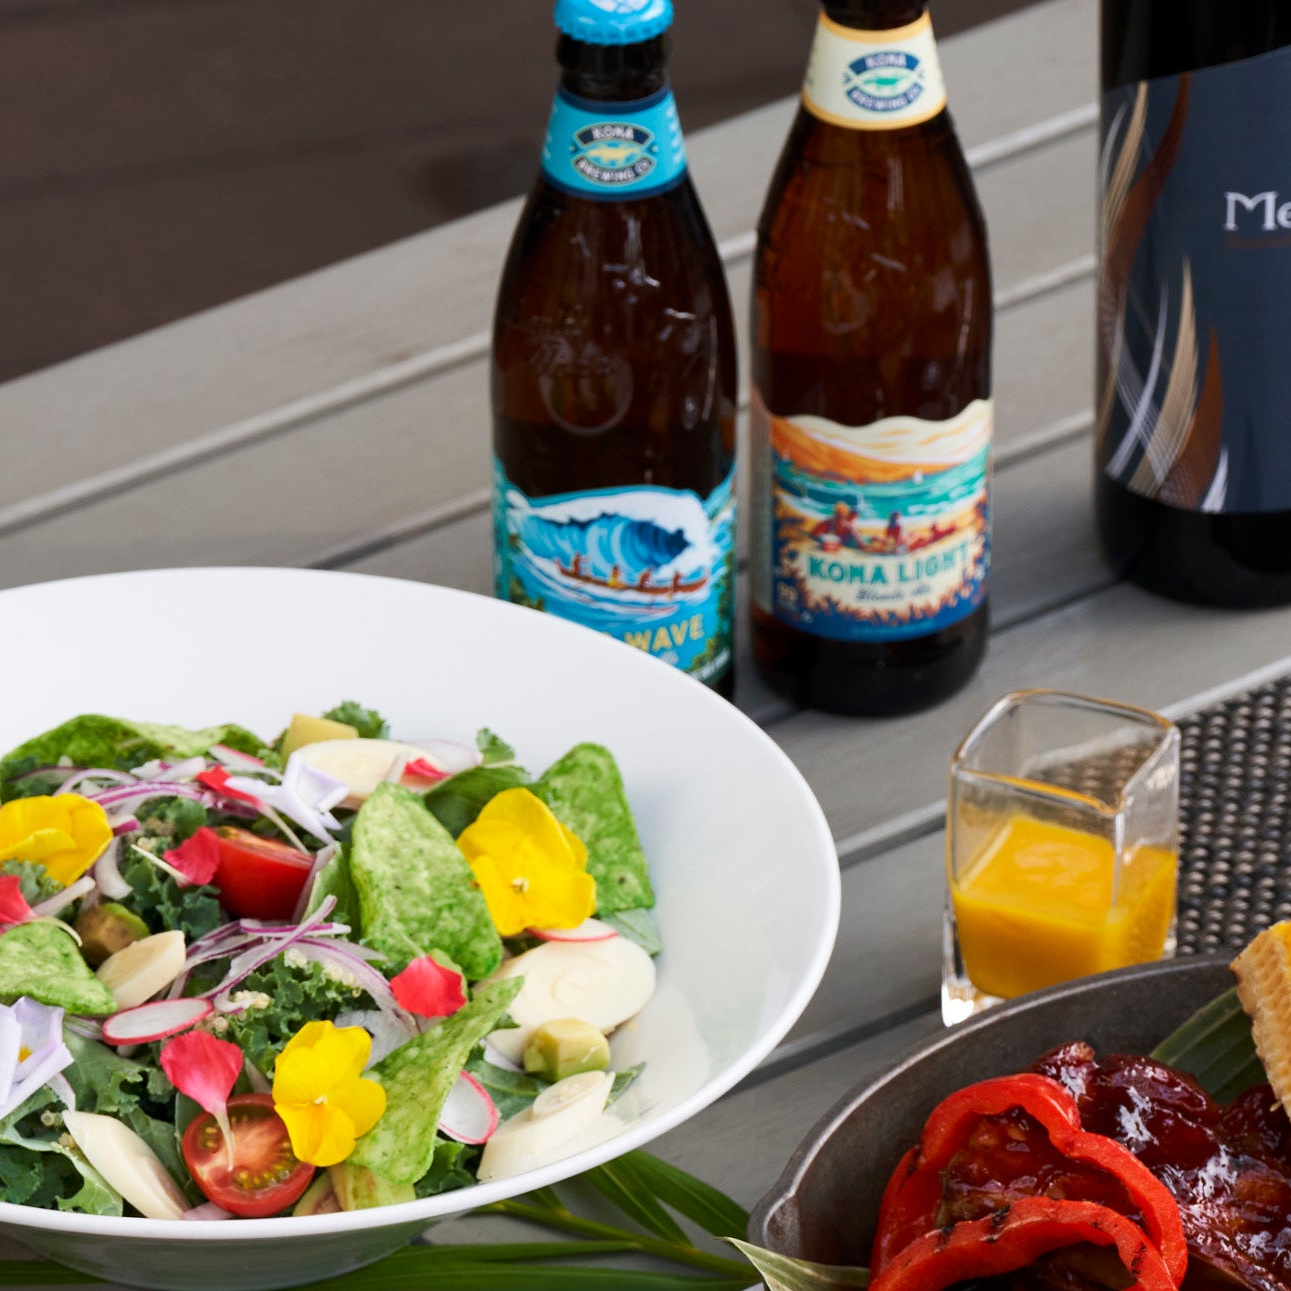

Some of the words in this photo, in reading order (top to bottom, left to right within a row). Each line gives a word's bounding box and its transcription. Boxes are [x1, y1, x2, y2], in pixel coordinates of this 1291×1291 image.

[591, 125, 635, 140] KONA
[809, 556, 887, 585] KONA
[898, 541, 969, 583] LIGHT
[624, 613, 705, 653] WAVE
